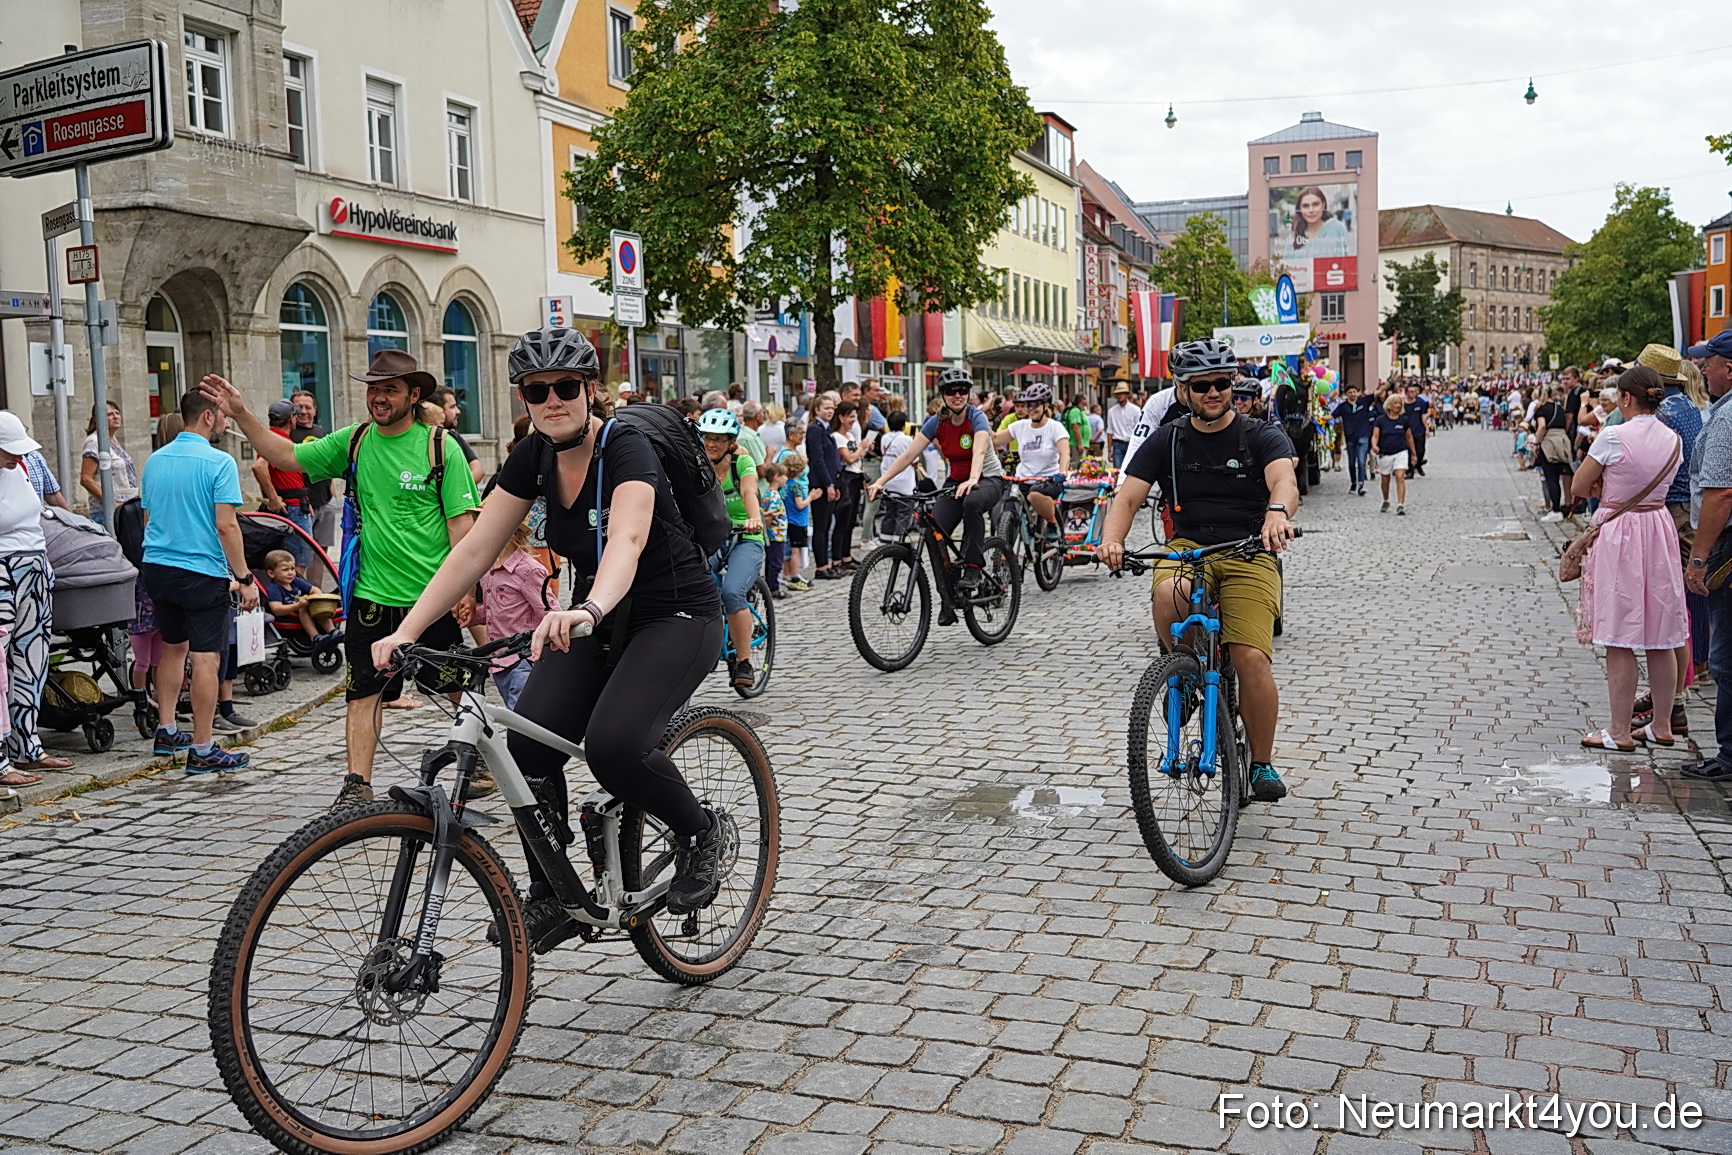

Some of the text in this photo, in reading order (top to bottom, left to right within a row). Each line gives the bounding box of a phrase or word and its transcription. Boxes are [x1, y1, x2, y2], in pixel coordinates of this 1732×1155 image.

[13, 66, 120, 108] Parkleitsystem
[53, 114, 124, 143] Rosengasse
[45, 211, 76, 233] Rosengass
[349, 202, 458, 242] HypoVereinsbank
[622, 275, 636, 286] ZONE
[399, 482, 426, 491] TEAM
[726, 496, 741, 504] TEA
[533, 808, 561, 853] CUBE
[472, 850, 497, 877] NIC
[416, 893, 444, 956] ROCKSHOX
[497, 883, 523, 955] NOBBY
[724, 896, 768, 963] SCHWALBE
